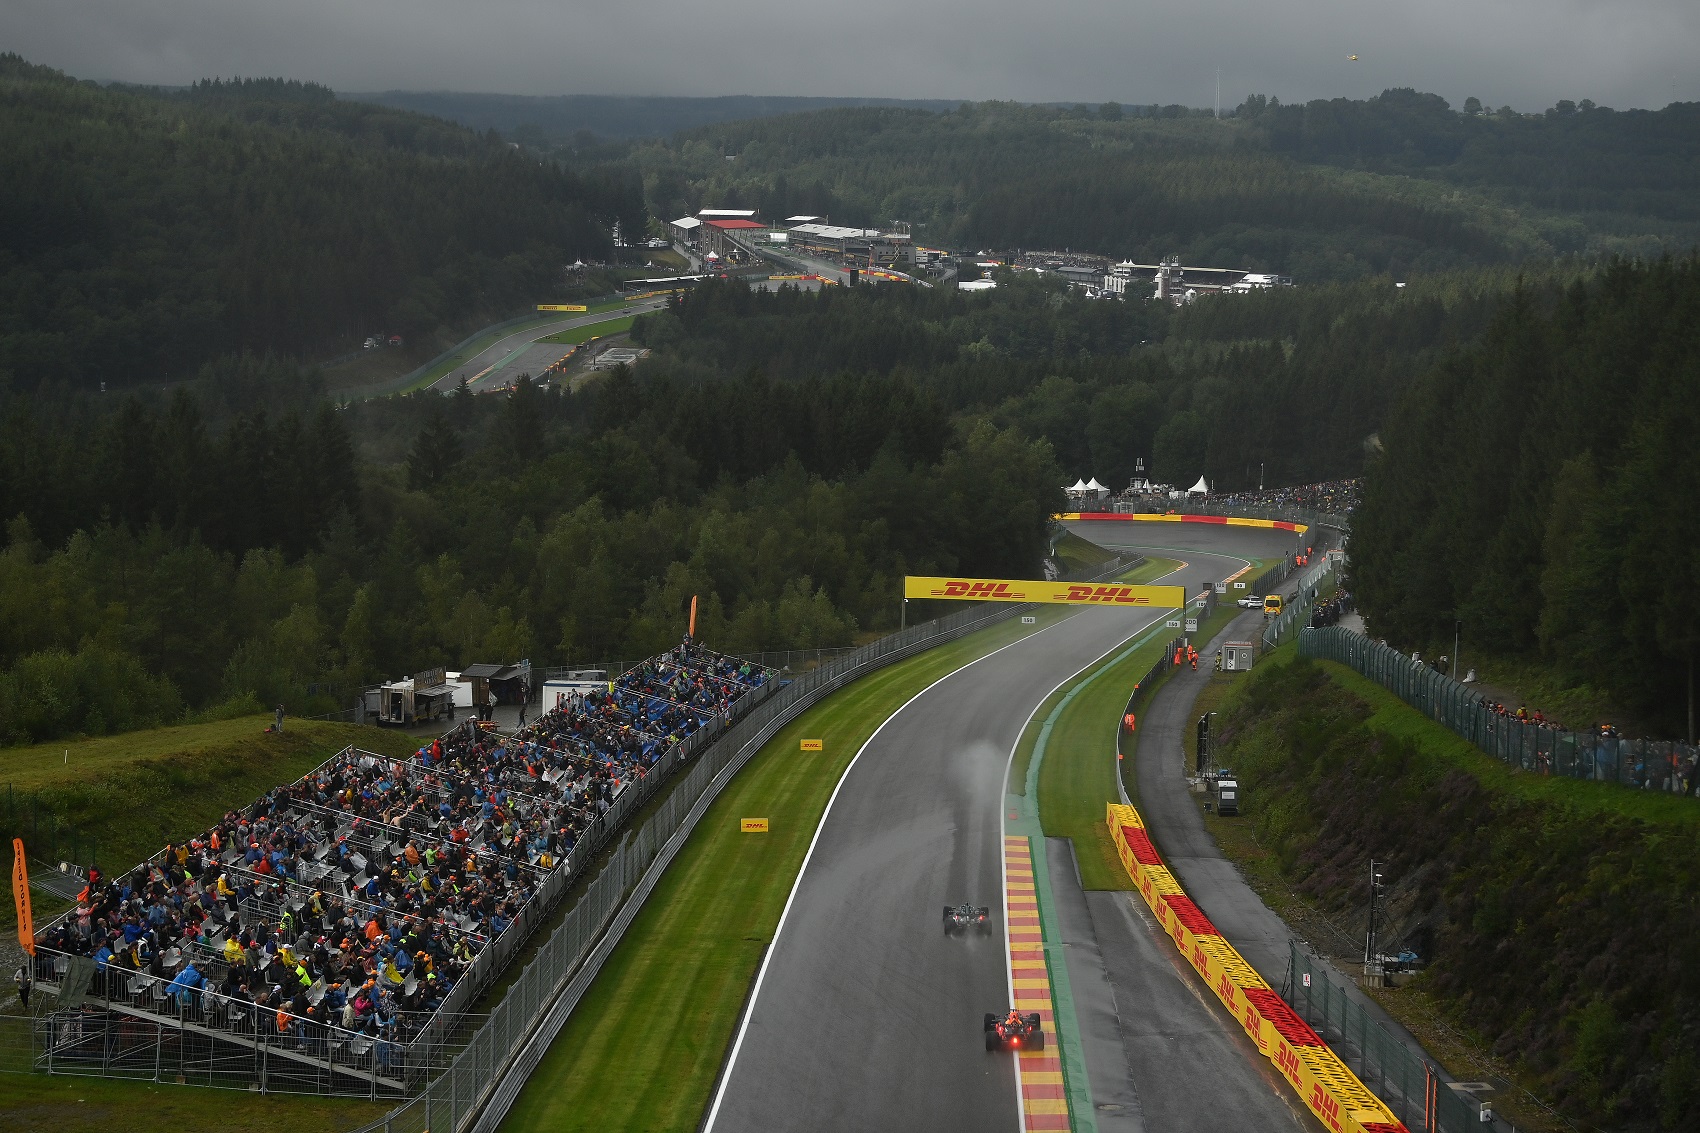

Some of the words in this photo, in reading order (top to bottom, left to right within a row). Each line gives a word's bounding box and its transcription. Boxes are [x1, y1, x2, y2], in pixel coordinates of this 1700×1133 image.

[944, 581, 1014, 598] DHL
[1066, 585, 1137, 603] DHL
[1194, 944, 1208, 978] DHL
[1220, 973, 1235, 1011] DHL
[1278, 1040, 1300, 1086] DHL
[1312, 1082, 1340, 1133] DHL
